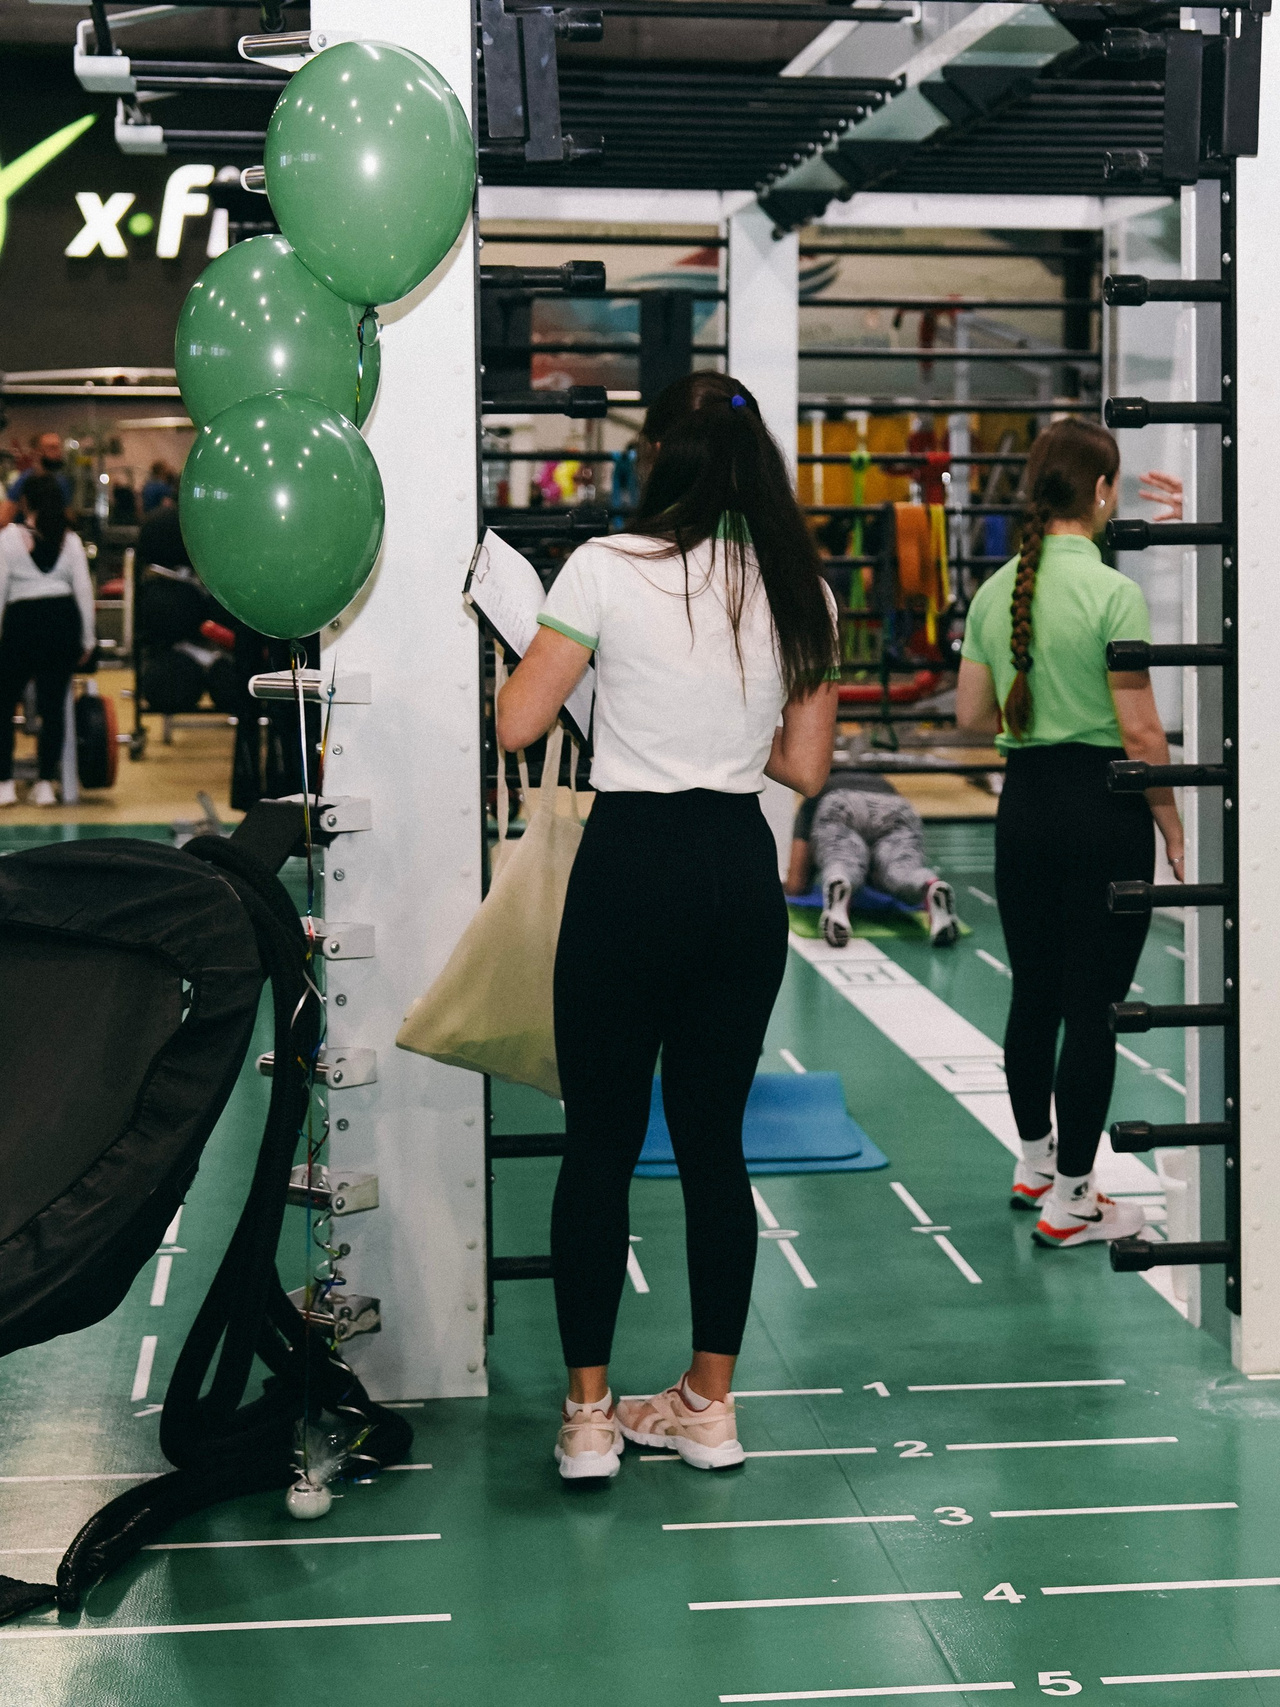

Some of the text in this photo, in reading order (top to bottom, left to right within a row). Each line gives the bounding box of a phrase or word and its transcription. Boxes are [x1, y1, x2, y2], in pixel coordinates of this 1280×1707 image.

[862, 1381, 891, 1397] 1
[893, 1440, 934, 1458] 2
[932, 1506, 974, 1526] 3
[982, 1582, 1027, 1604] 4
[1037, 1670, 1083, 1697] 5
